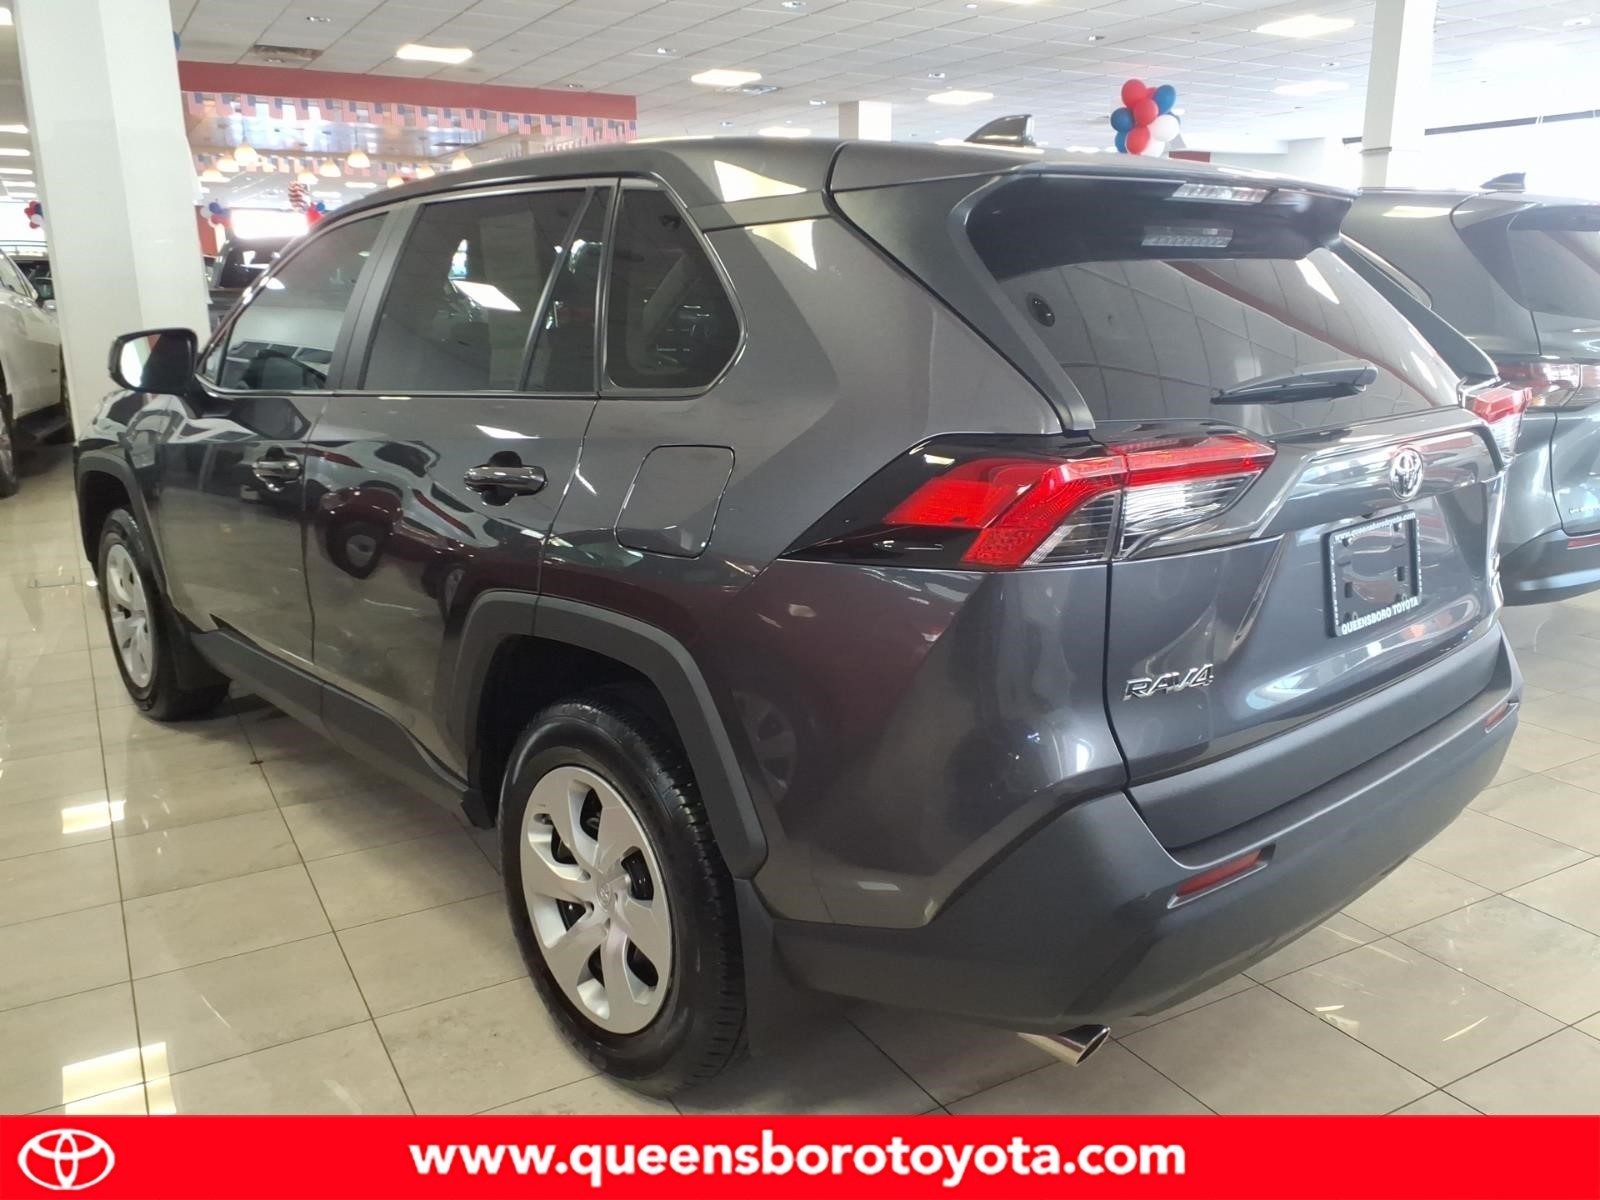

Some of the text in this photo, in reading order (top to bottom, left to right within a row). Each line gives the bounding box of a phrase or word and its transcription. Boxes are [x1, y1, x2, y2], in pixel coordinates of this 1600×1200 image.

[1341, 597, 1419, 635] QUEENSBORO TOYOTA
[1122, 663, 1214, 701] RAV4
